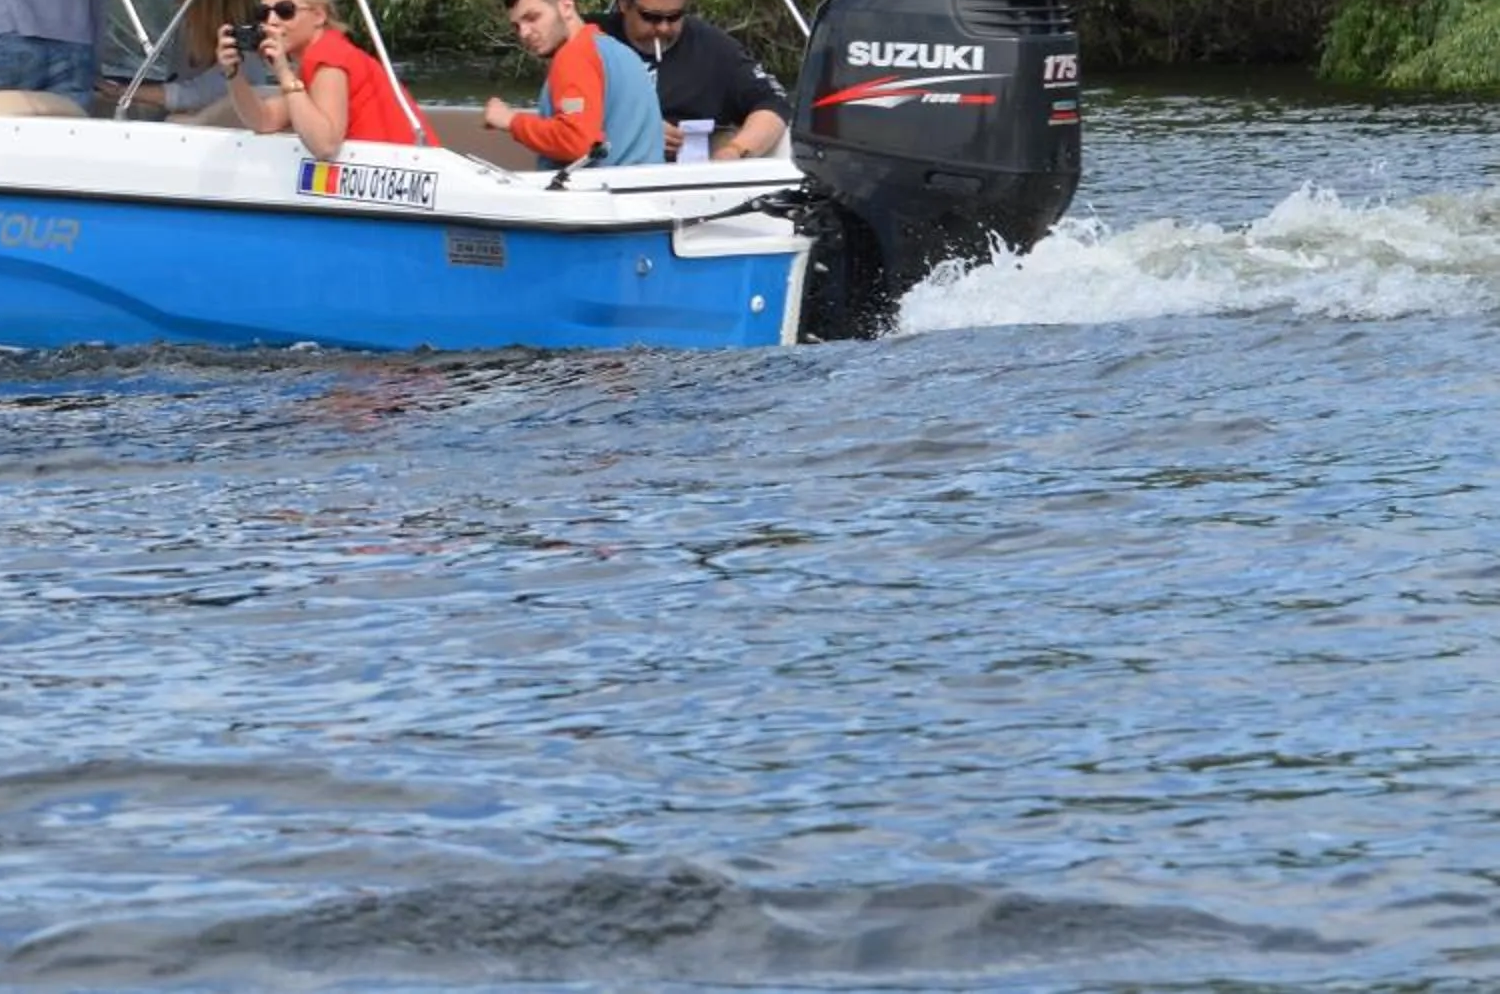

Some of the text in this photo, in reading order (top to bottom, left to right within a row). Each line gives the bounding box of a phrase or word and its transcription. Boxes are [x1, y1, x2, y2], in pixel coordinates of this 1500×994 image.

[847, 41, 985, 71] SUZUKI
[1044, 54, 1077, 80] 175
[340, 167, 431, 204] ROU 0184-MC
